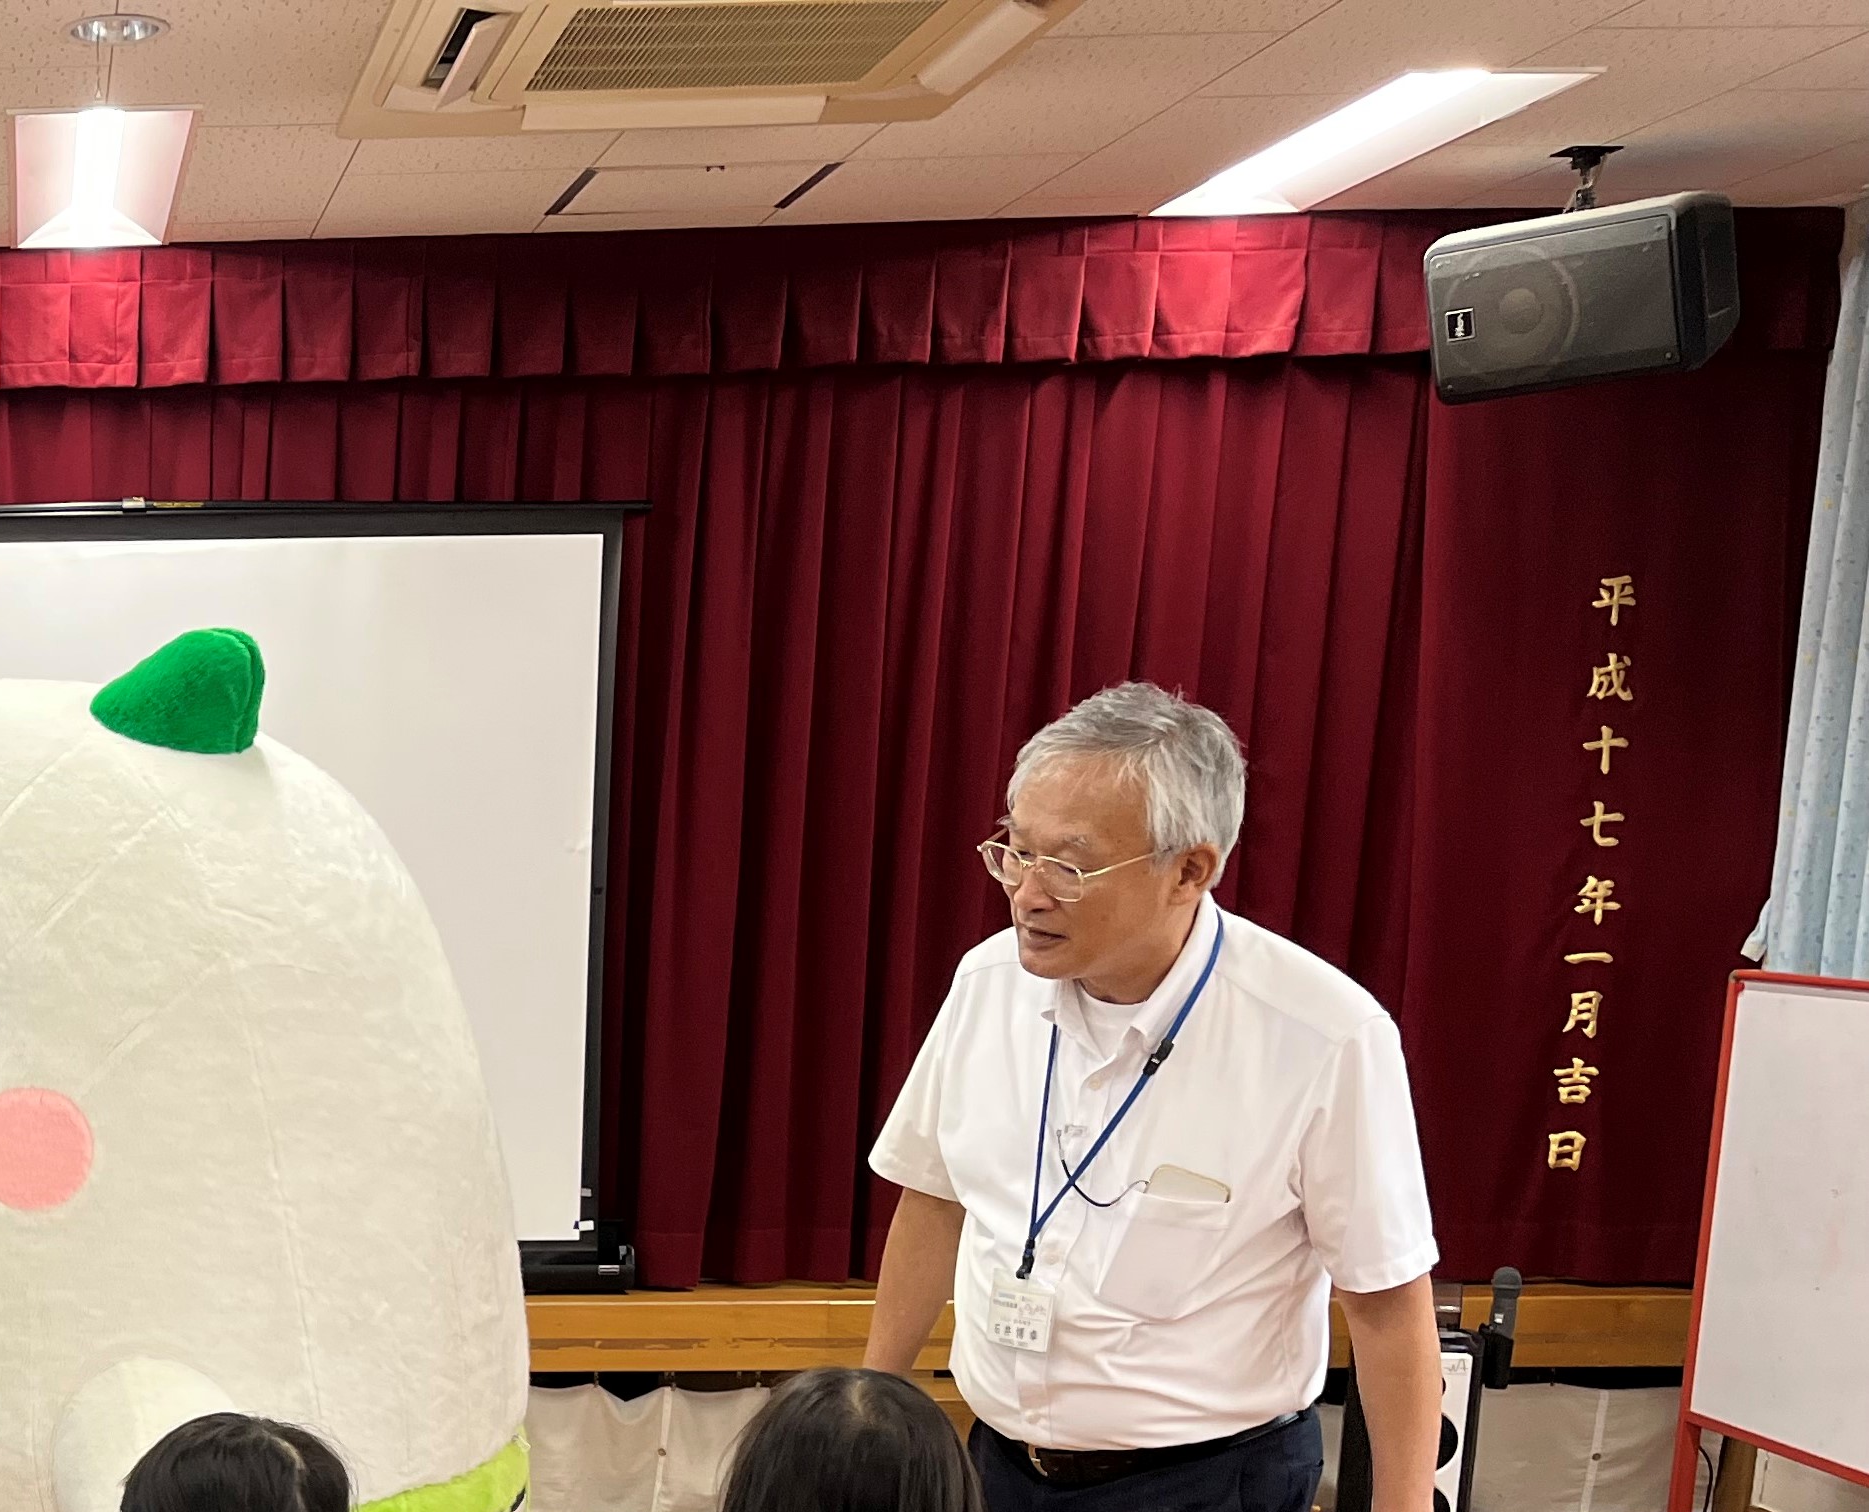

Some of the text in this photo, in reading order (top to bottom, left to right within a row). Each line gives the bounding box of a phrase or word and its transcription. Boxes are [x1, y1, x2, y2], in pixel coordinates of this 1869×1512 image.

[1546, 574, 1637, 1172] 平成十七年一月吉日
